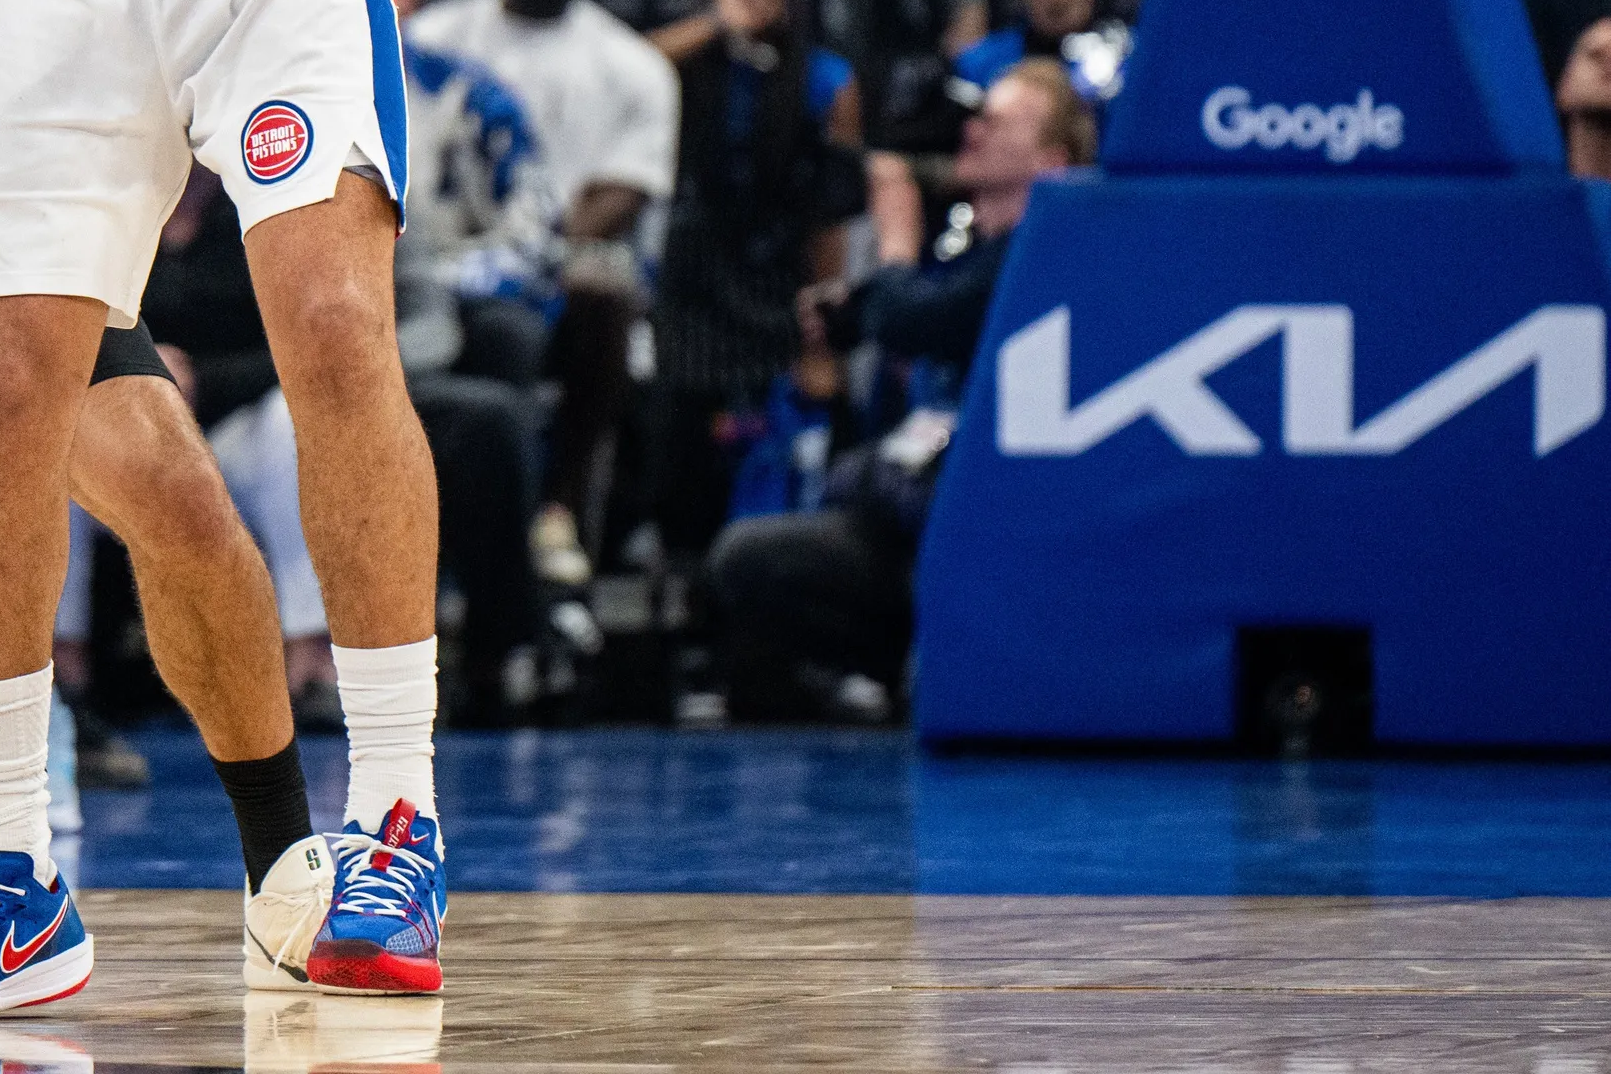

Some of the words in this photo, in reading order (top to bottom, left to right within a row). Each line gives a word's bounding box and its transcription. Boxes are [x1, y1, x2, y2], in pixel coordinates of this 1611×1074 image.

[250, 123, 296, 148] DETROIT
[251, 137, 298, 162] PISTONS
[1201, 86, 1405, 163] Google
[996, 302, 1607, 458] KIA
